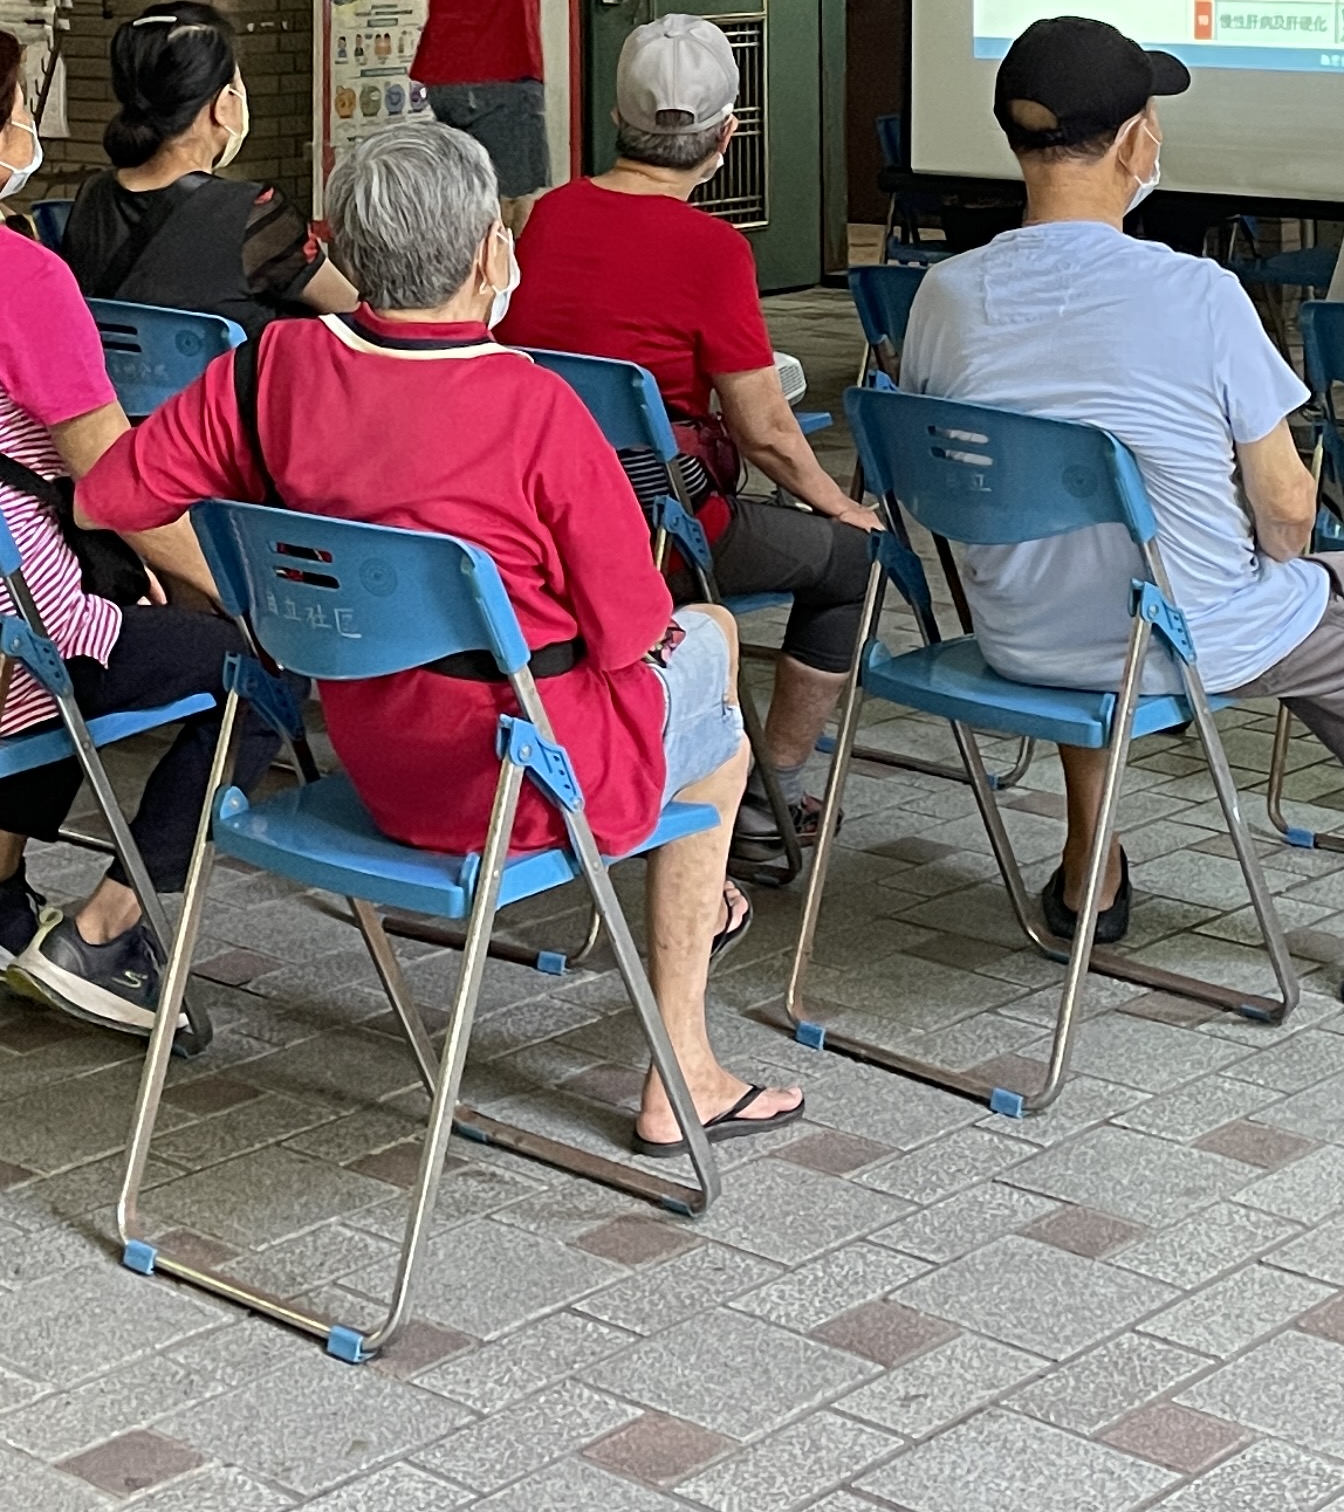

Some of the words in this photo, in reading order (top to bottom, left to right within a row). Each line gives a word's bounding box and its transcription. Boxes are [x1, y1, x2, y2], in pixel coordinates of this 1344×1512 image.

[1220, 15, 1328, 32] 慢性肝病及肝硬化
